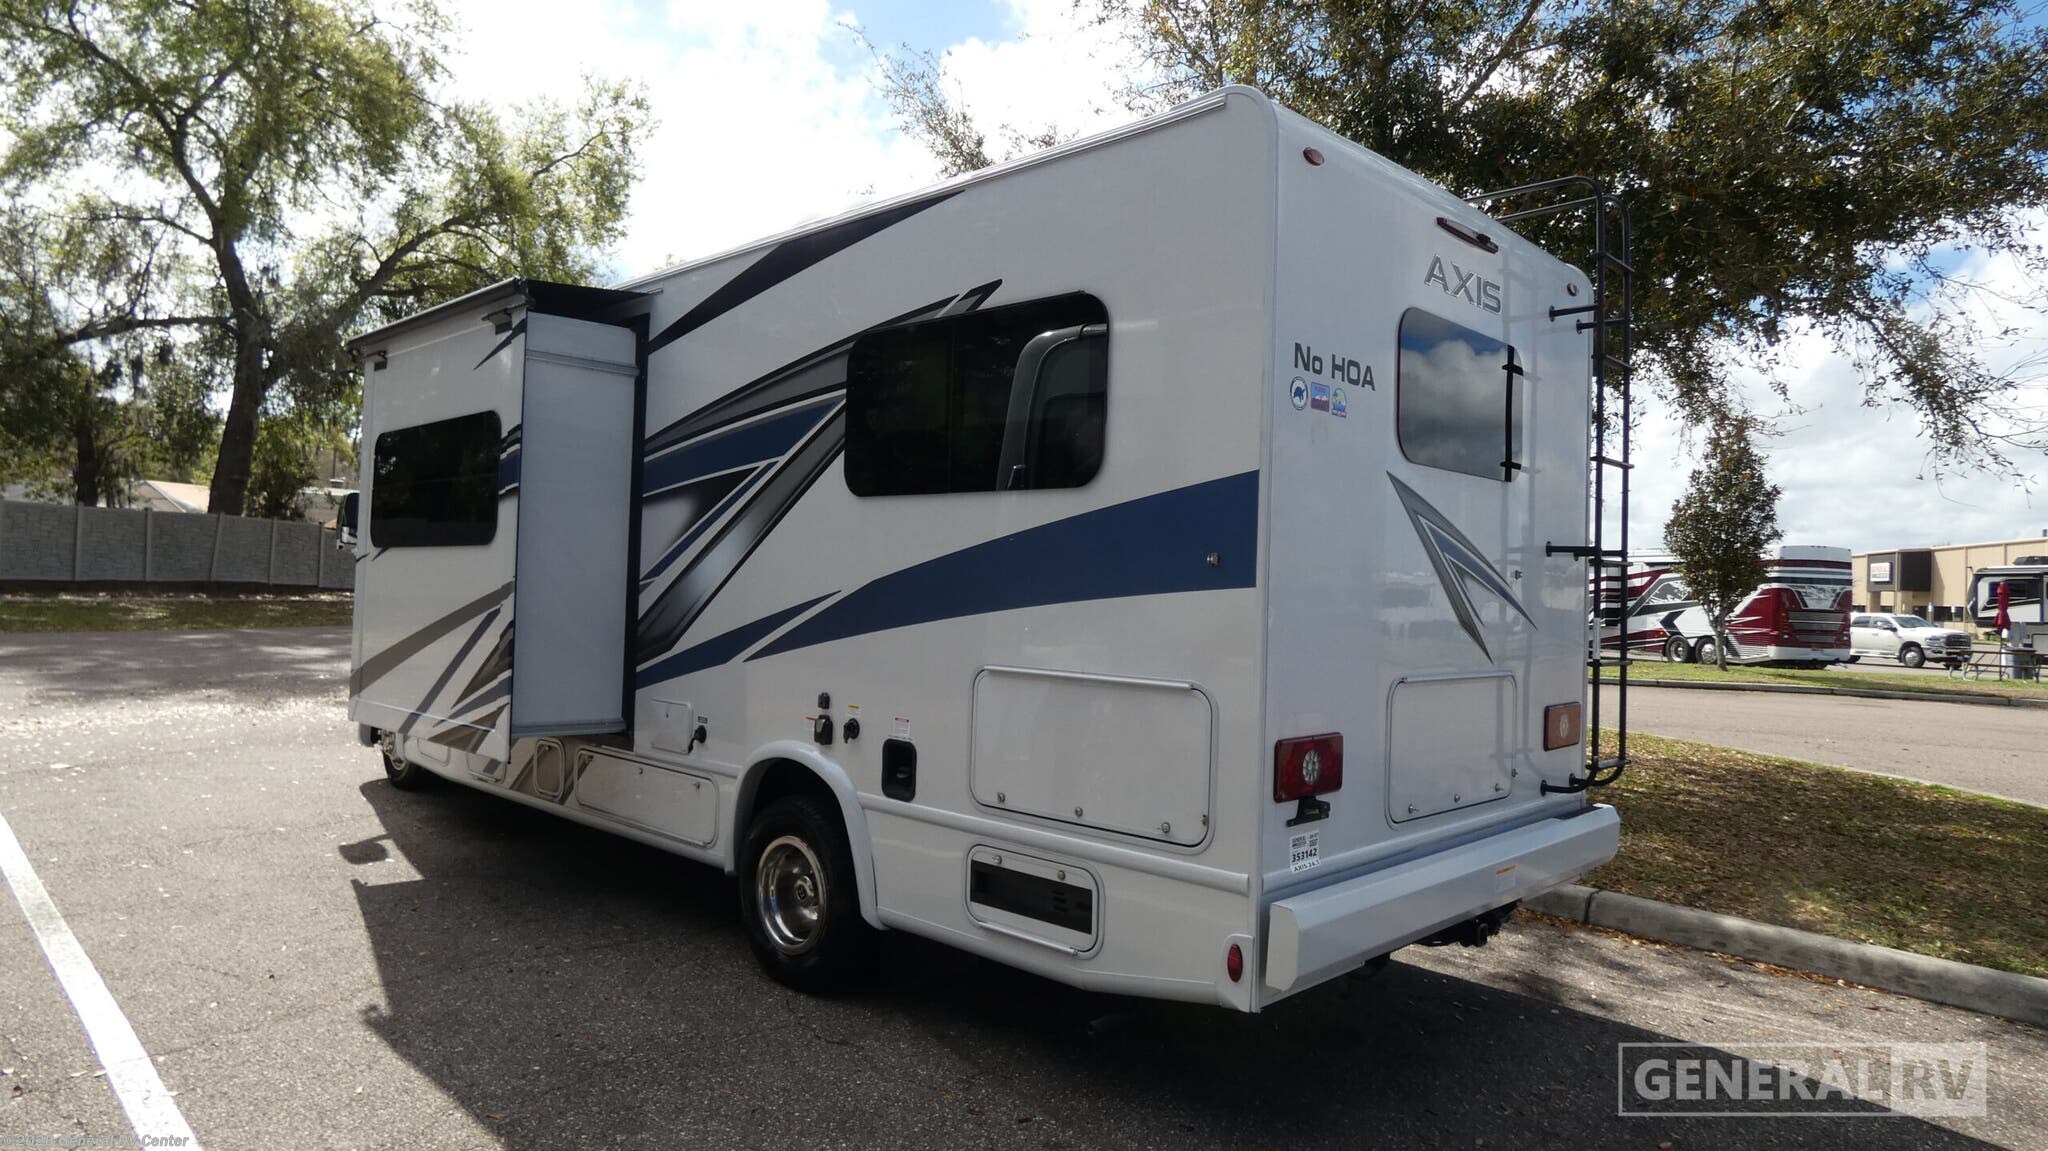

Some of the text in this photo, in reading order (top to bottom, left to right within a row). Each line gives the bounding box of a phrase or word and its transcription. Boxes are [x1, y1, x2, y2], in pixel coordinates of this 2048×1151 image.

[1424, 254, 1502, 315] AXIS
[1294, 342, 1376, 391] No HOA
[1292, 848, 1317, 863] 353142
[1294, 864, 1308, 872] AXIS
